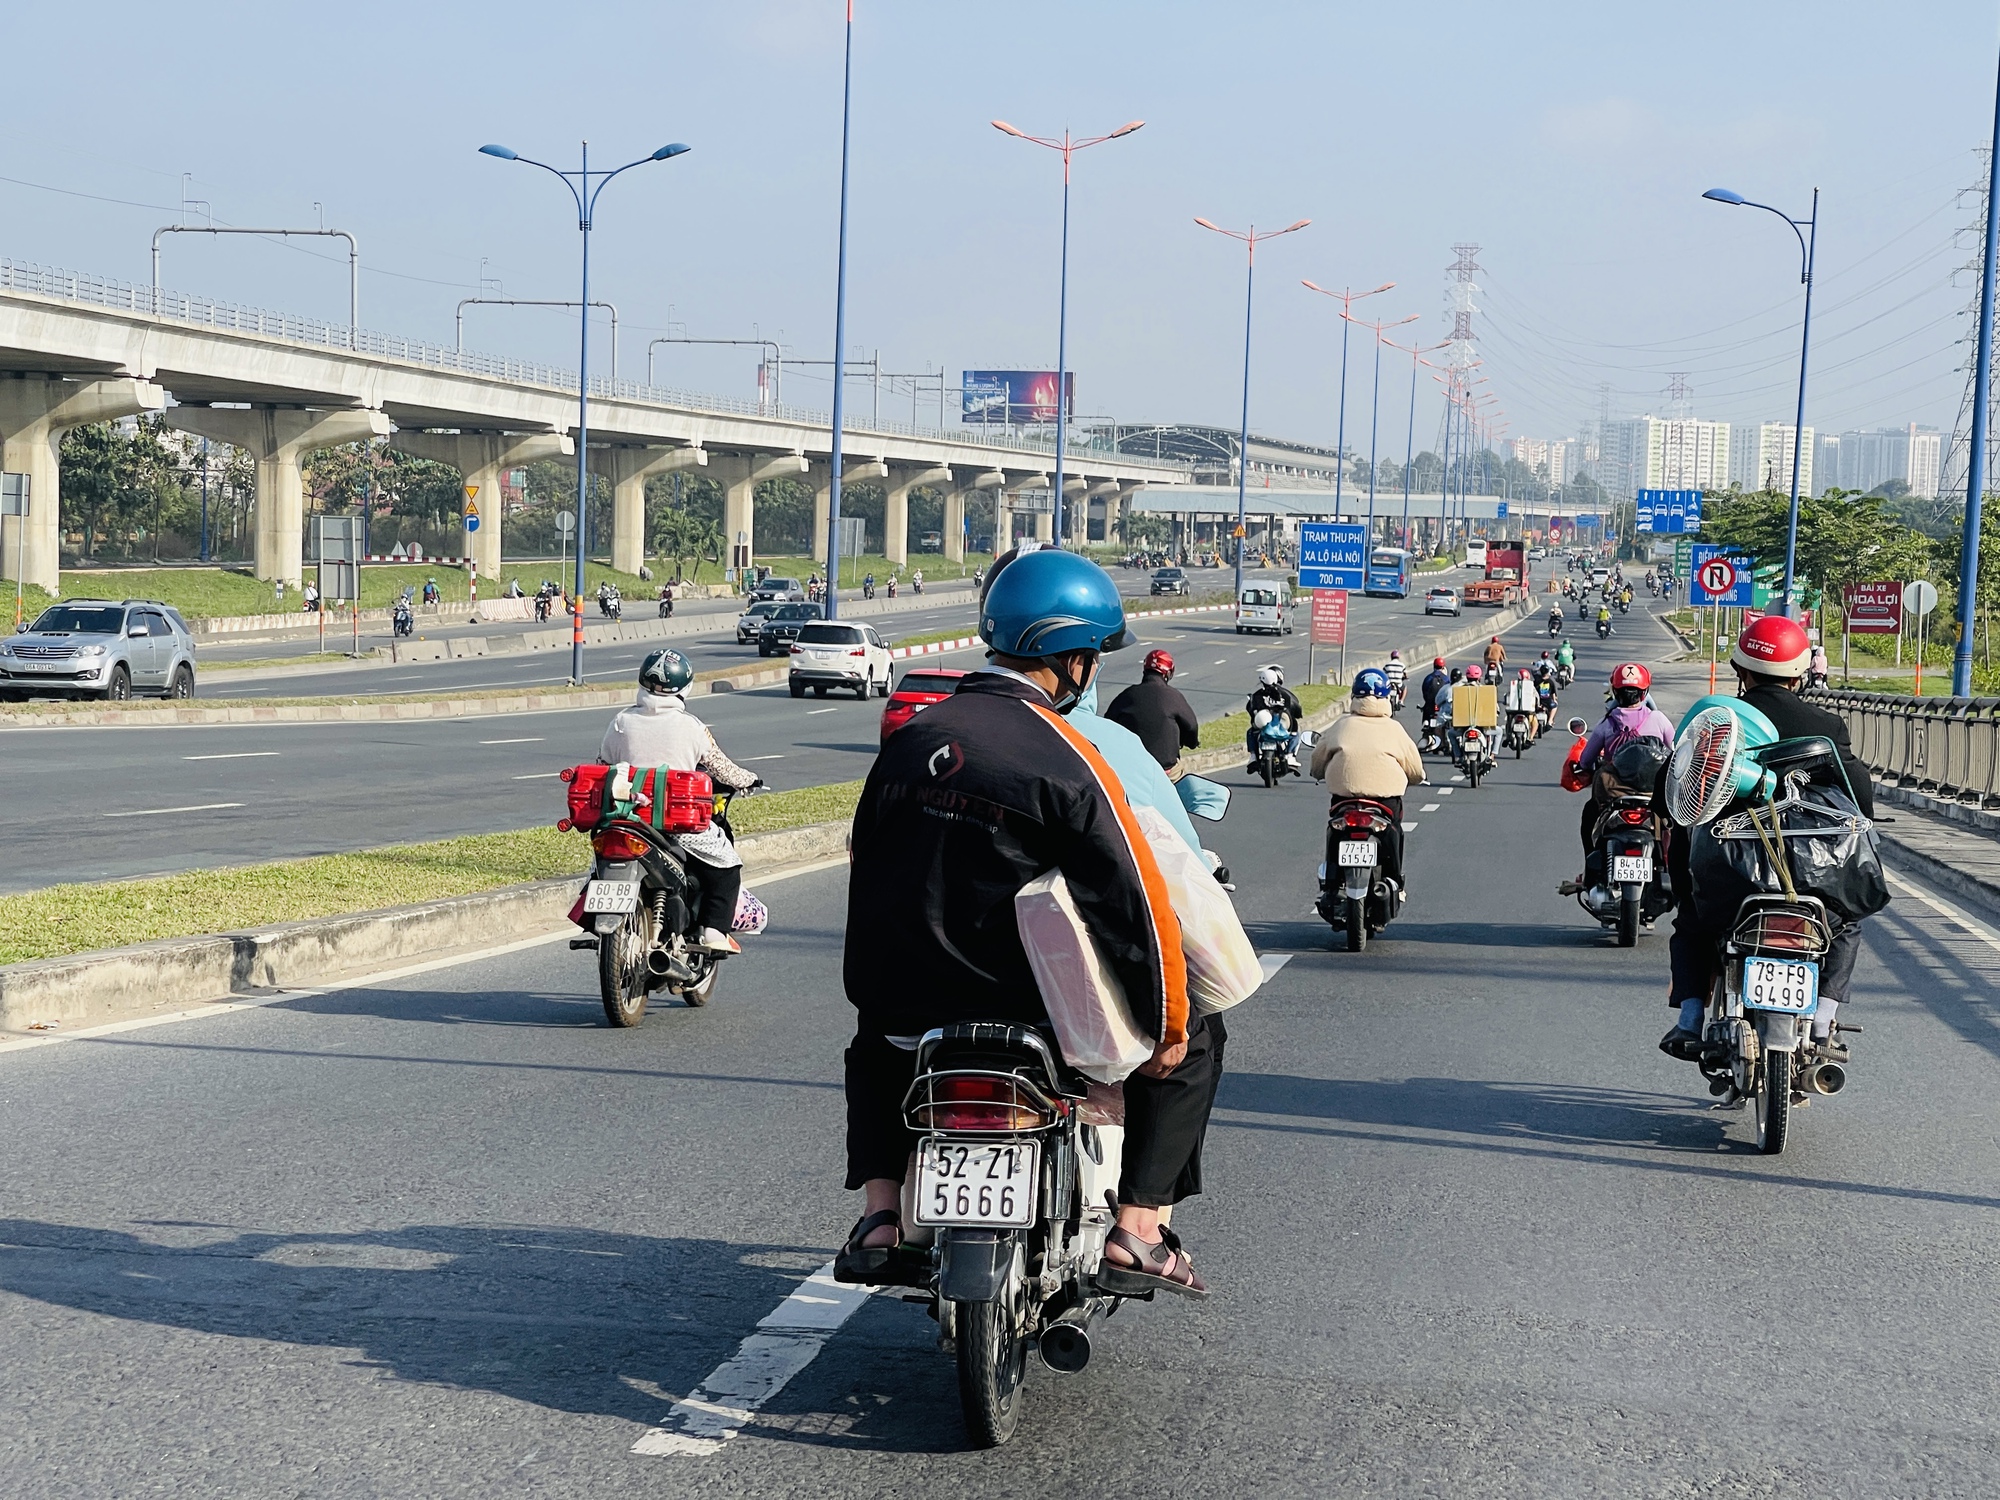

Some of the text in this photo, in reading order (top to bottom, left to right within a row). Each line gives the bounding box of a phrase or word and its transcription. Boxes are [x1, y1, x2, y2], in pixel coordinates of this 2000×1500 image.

[1304, 530, 1364, 544] TRẠM THU PHÍ
[1304, 548, 1360, 566] XA LỘ HÀ NỘI
[1319, 573, 1343, 585] 700 m
[1849, 594, 1898, 606] HOA LỢI
[1761, 646, 1774, 655] CHI
[1345, 844, 1370, 853] 77-F1
[1620, 859, 1645, 869] 84-G1
[596, 883, 631, 896] 60-B8
[588, 897, 634, 910] 863.77
[1757, 962, 1805, 985] 78-F9
[1754, 985, 1804, 1008] 9499
[937, 1146, 1014, 1179] 52-Z1
[934, 1183, 1015, 1217] 5666
